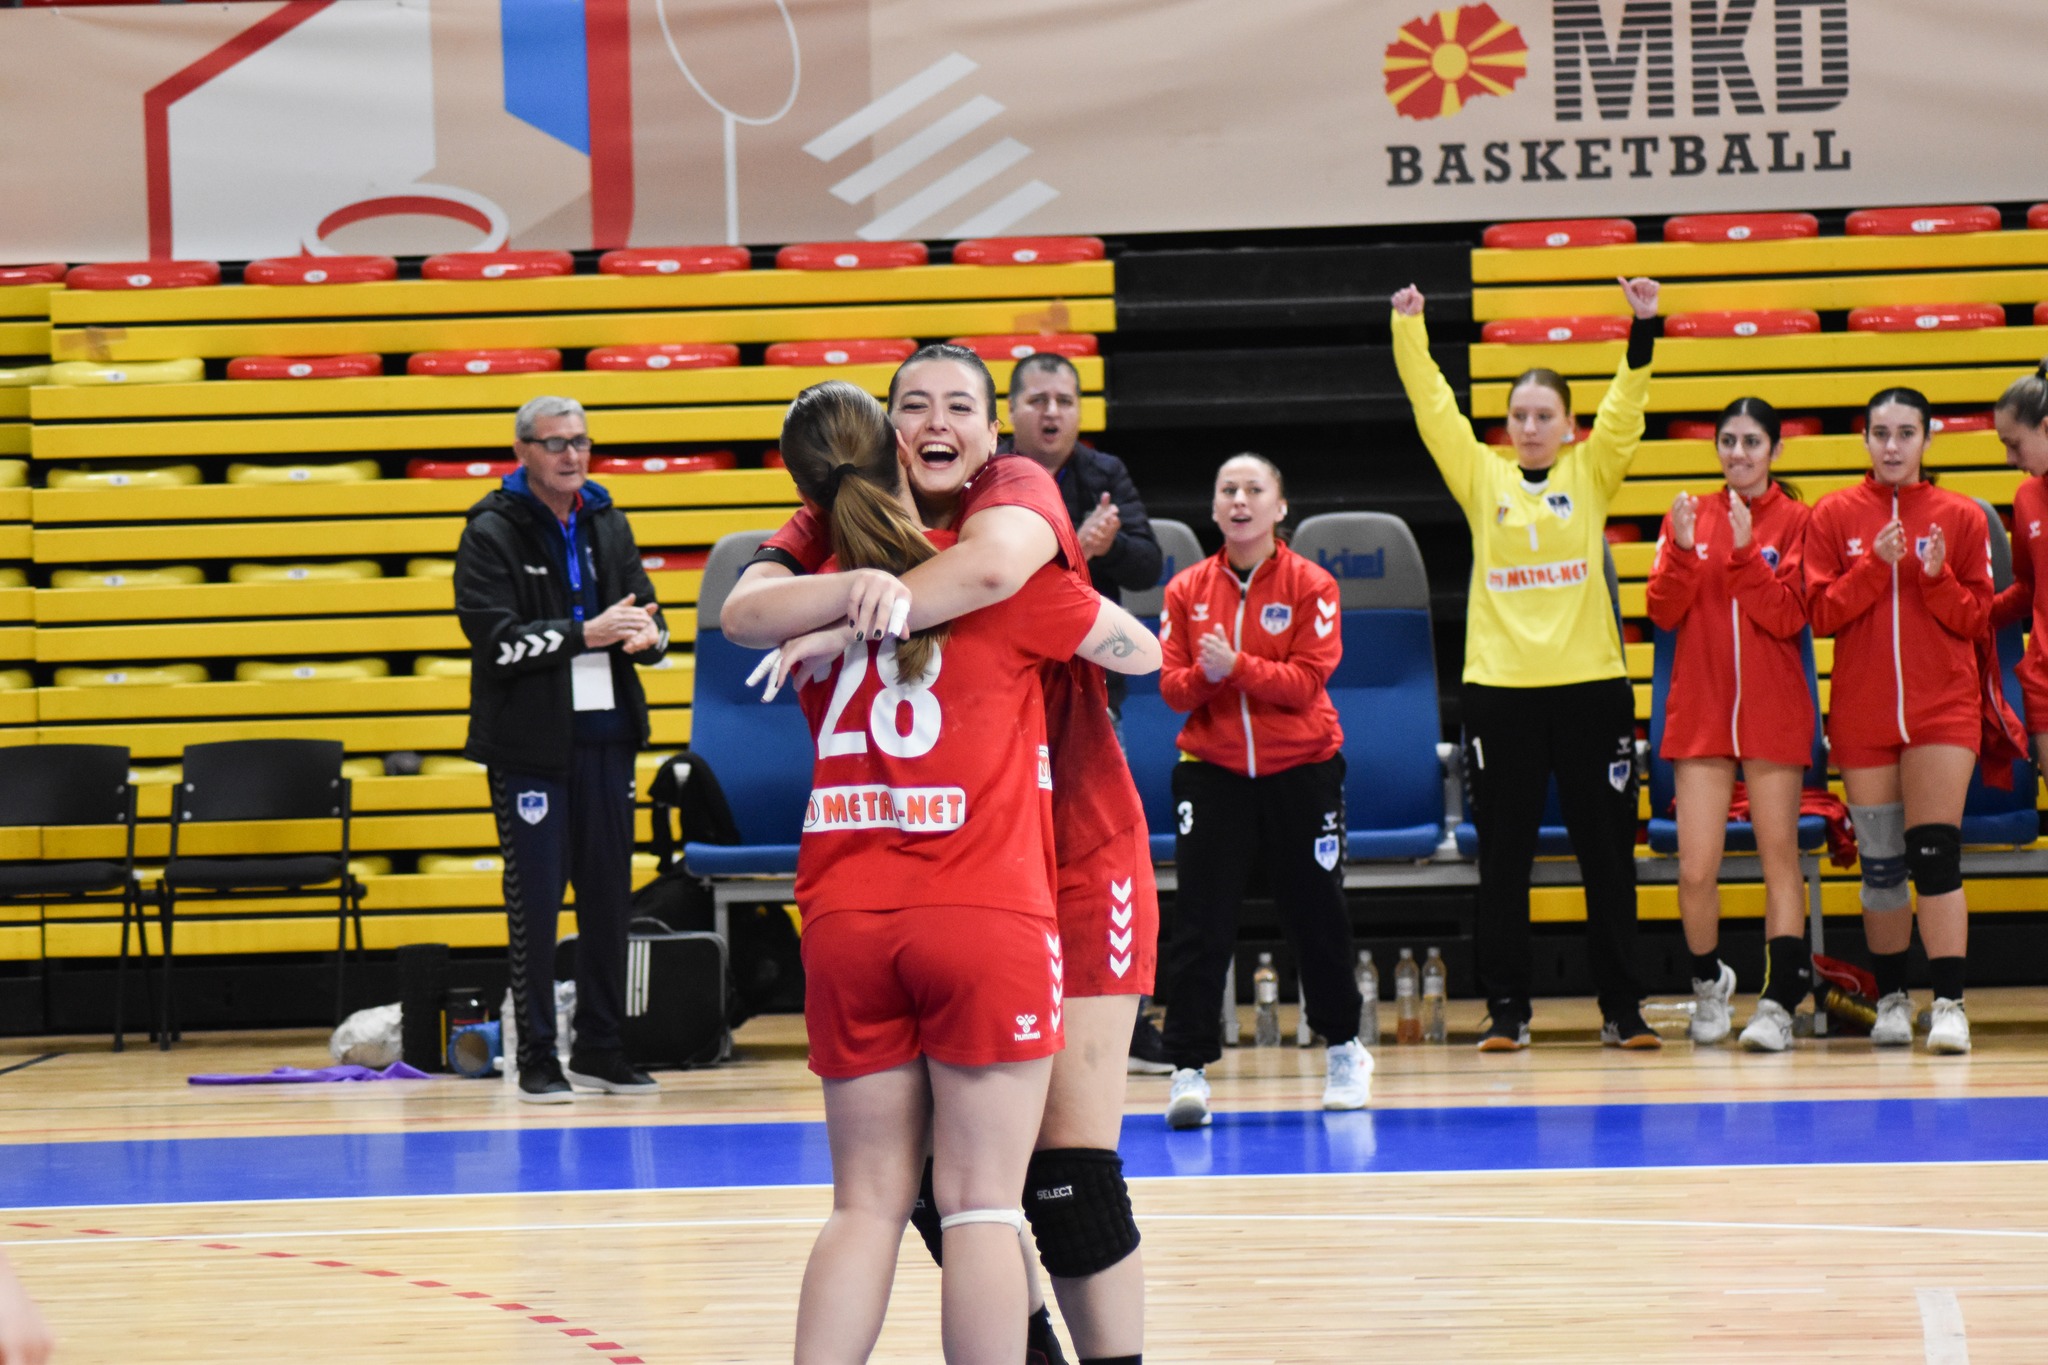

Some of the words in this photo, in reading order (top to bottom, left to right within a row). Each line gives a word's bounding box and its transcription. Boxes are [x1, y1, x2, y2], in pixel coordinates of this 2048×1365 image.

[1553, 0, 1849, 121] MKD
[1386, 129, 1852, 186] BASKETBALL
[812, 638, 942, 760] 28
[1177, 800, 1194, 836] 3
[1036, 1185, 1073, 1200] SELECT
